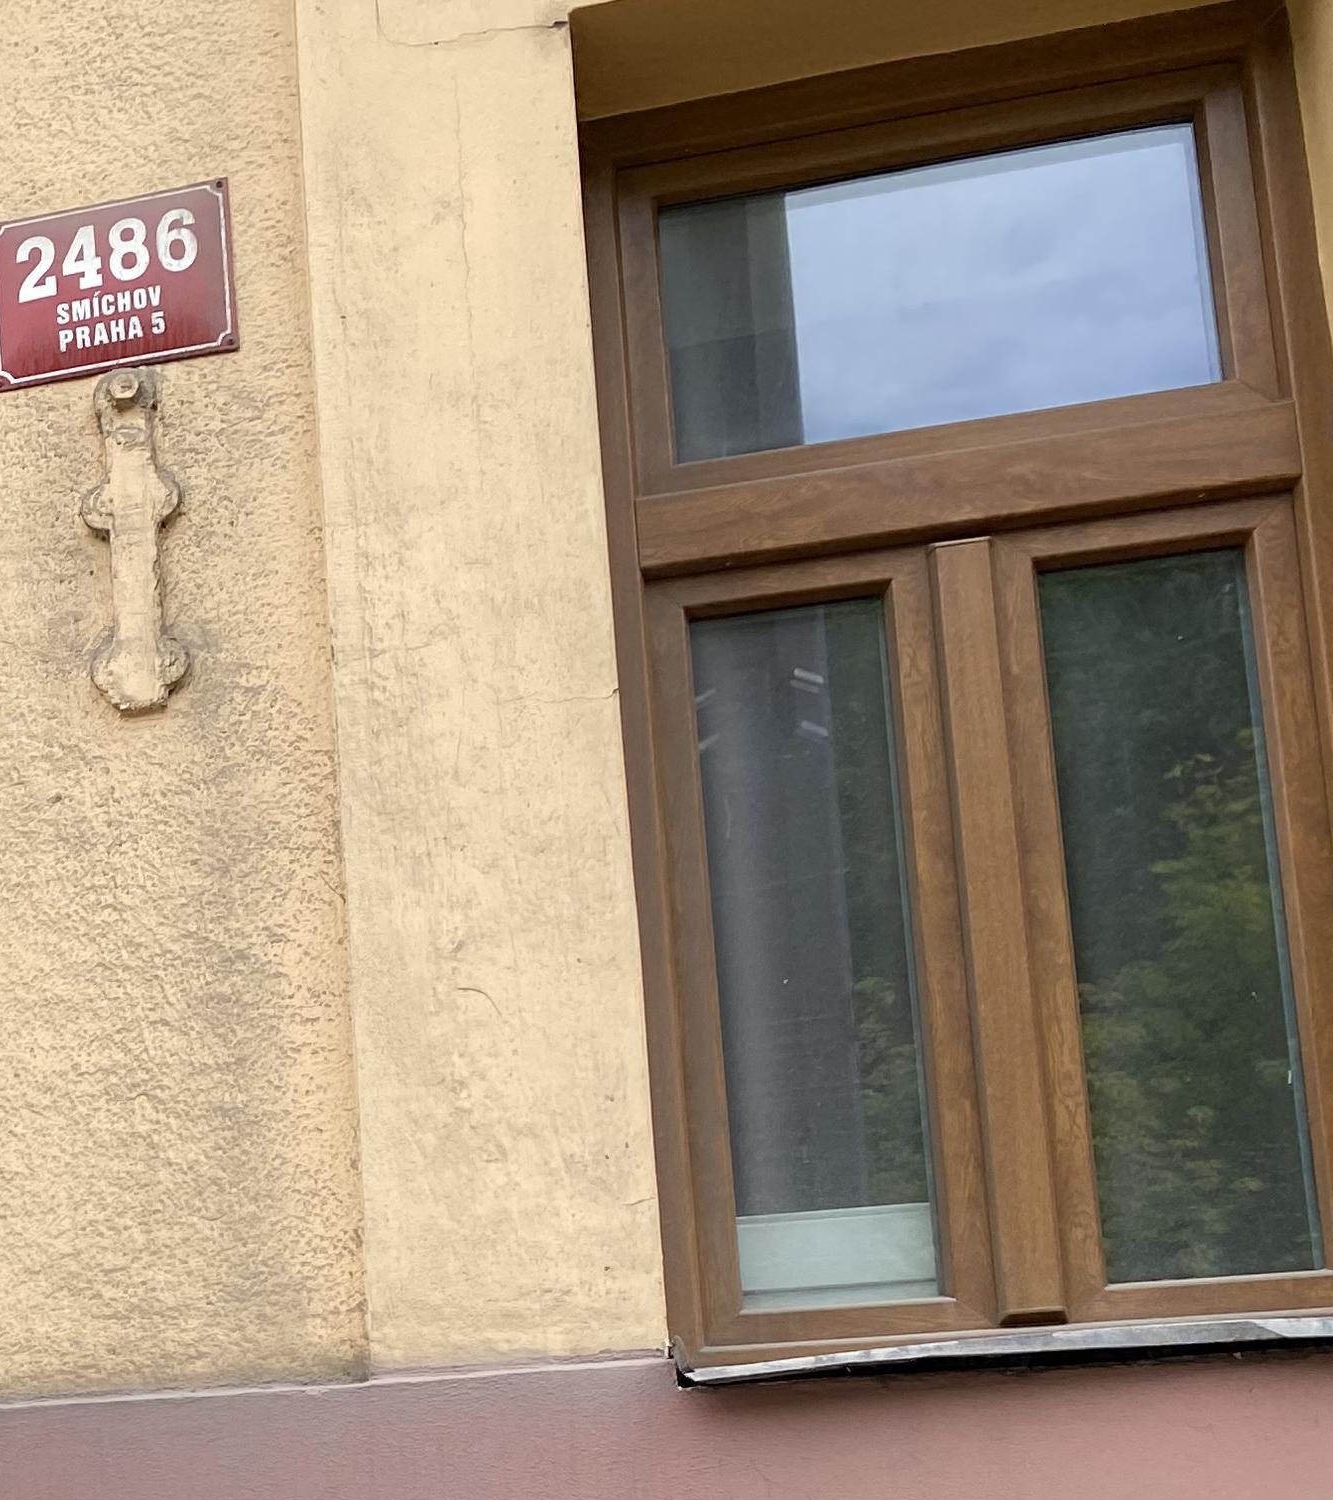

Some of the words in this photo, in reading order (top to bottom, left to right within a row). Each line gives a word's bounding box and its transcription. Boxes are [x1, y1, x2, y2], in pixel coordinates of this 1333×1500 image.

[15, 208, 198, 303] 2486
[56, 285, 162, 324] SMÍCHOV
[59, 316, 144, 352] PRAHA
[151, 311, 166, 335] 5
